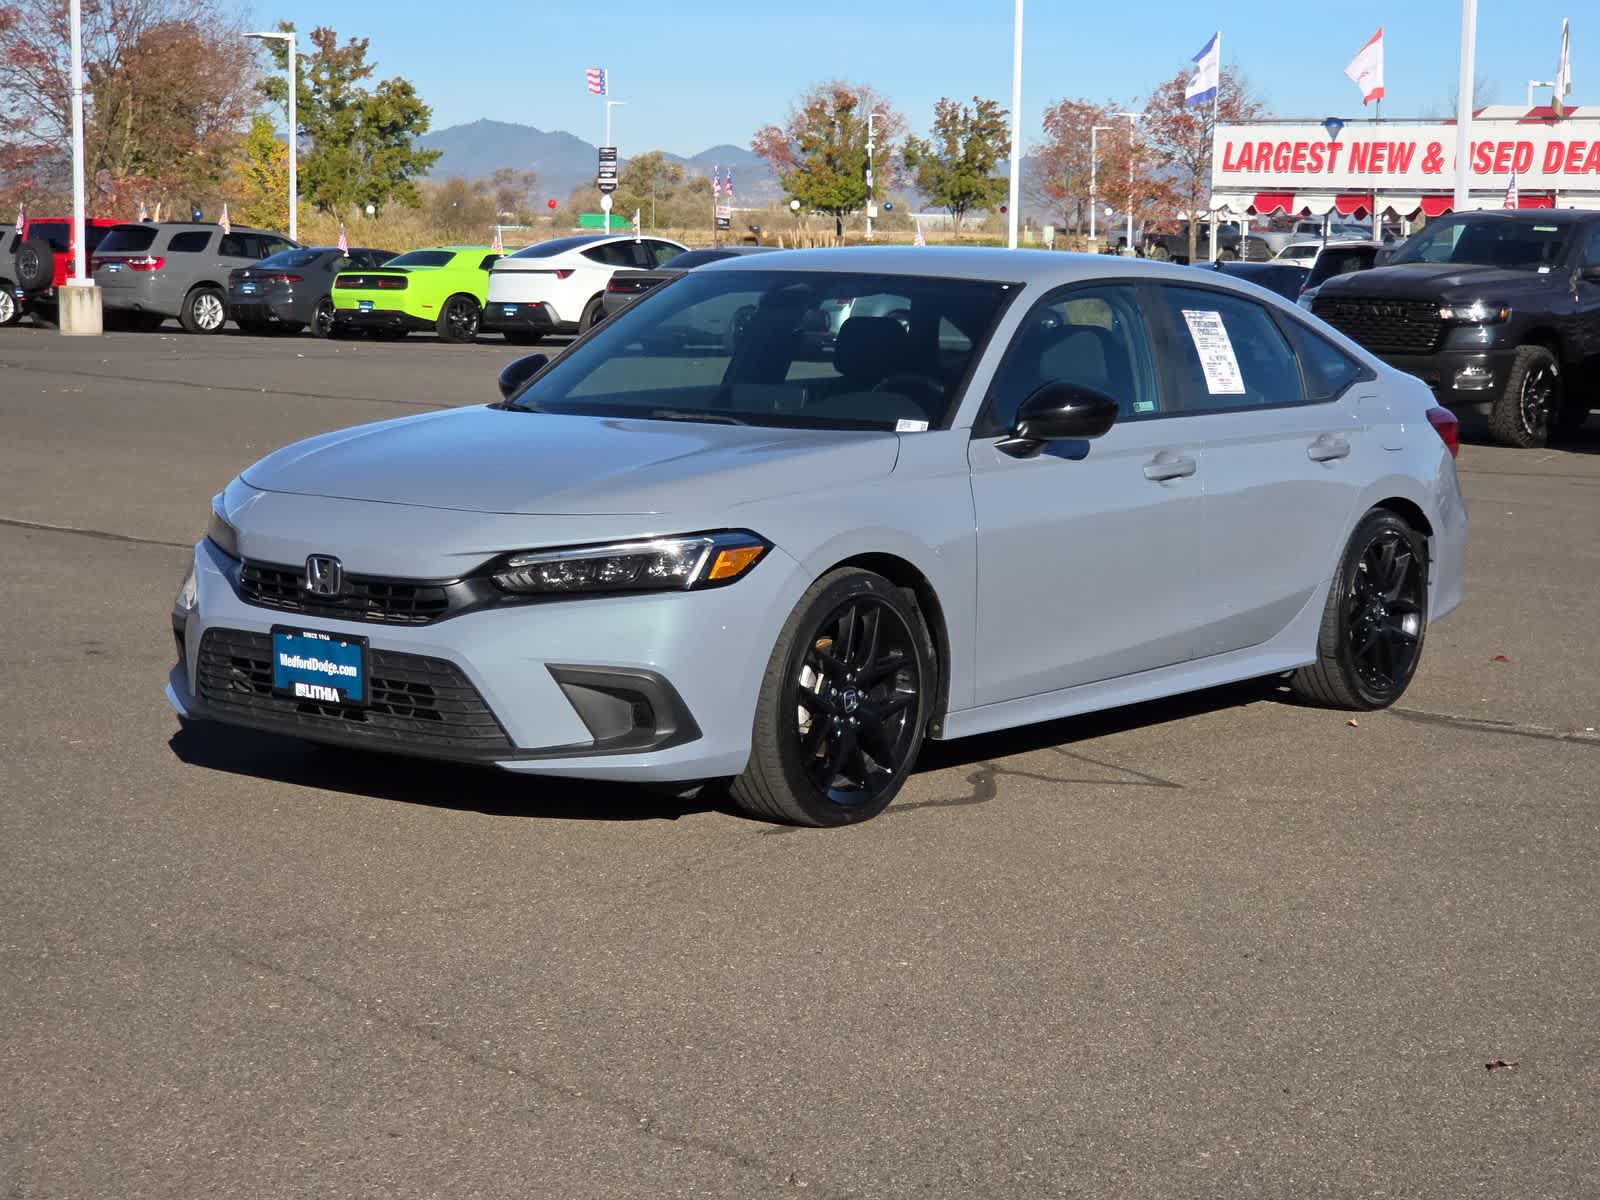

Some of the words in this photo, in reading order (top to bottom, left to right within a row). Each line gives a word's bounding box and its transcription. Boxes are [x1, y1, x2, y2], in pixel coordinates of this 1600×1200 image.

[1222, 142, 1343, 174] LARGEST
[1348, 142, 1416, 174] NEW
[1421, 142, 1445, 174] &
[280, 653, 357, 677] MedfordDodge.com
[305, 684, 340, 702] LITHIA
